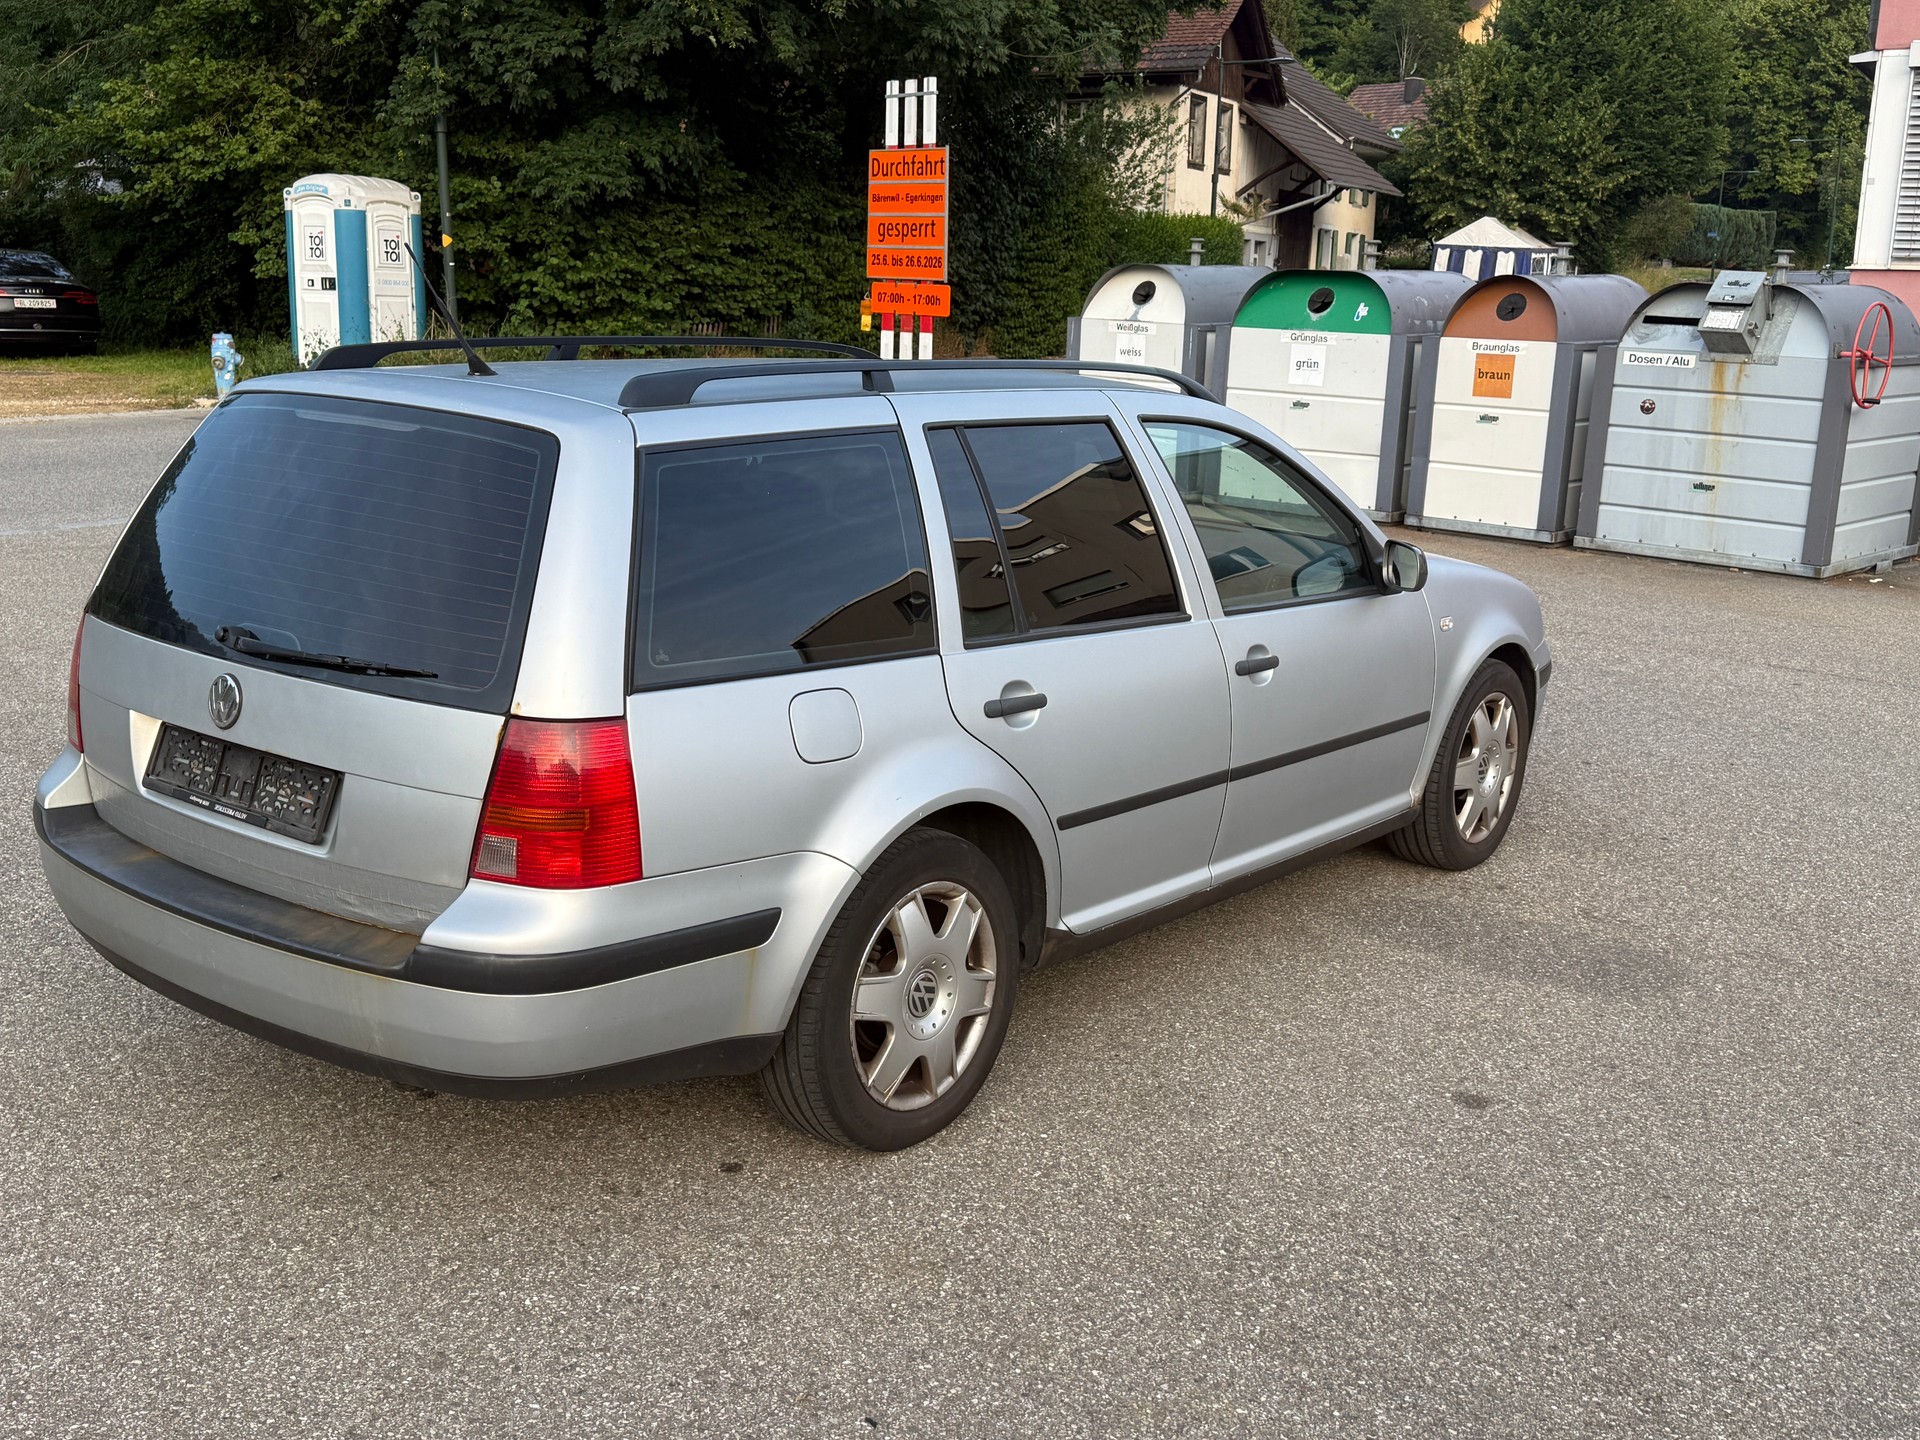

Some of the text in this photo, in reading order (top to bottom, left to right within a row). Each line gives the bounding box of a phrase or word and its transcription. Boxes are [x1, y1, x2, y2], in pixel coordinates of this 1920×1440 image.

[872, 154, 945, 177] Durchfahrt
[872, 193, 900, 203] Bärenwil
[905, 193, 943, 204] Egerkingen
[878, 219, 936, 242] gesperrt
[309, 235, 324, 246] TOI
[384, 239, 400, 250] TOI
[309, 247, 324, 258] TOI
[384, 251, 401, 262] TOI
[871, 254, 943, 268] 25.6. bis 26.6.2026
[877, 292, 904, 304] 07:00h
[912, 294, 941, 306] 17:00h
[1116, 323, 1149, 334] Weißglas
[1290, 332, 1328, 344] Grünglas
[1119, 347, 1142, 357] weiss
[1472, 341, 1520, 353] Braunglas
[1296, 358, 1319, 371] grün
[1629, 353, 1663, 365] Dosen
[1478, 368, 1511, 380] braun
